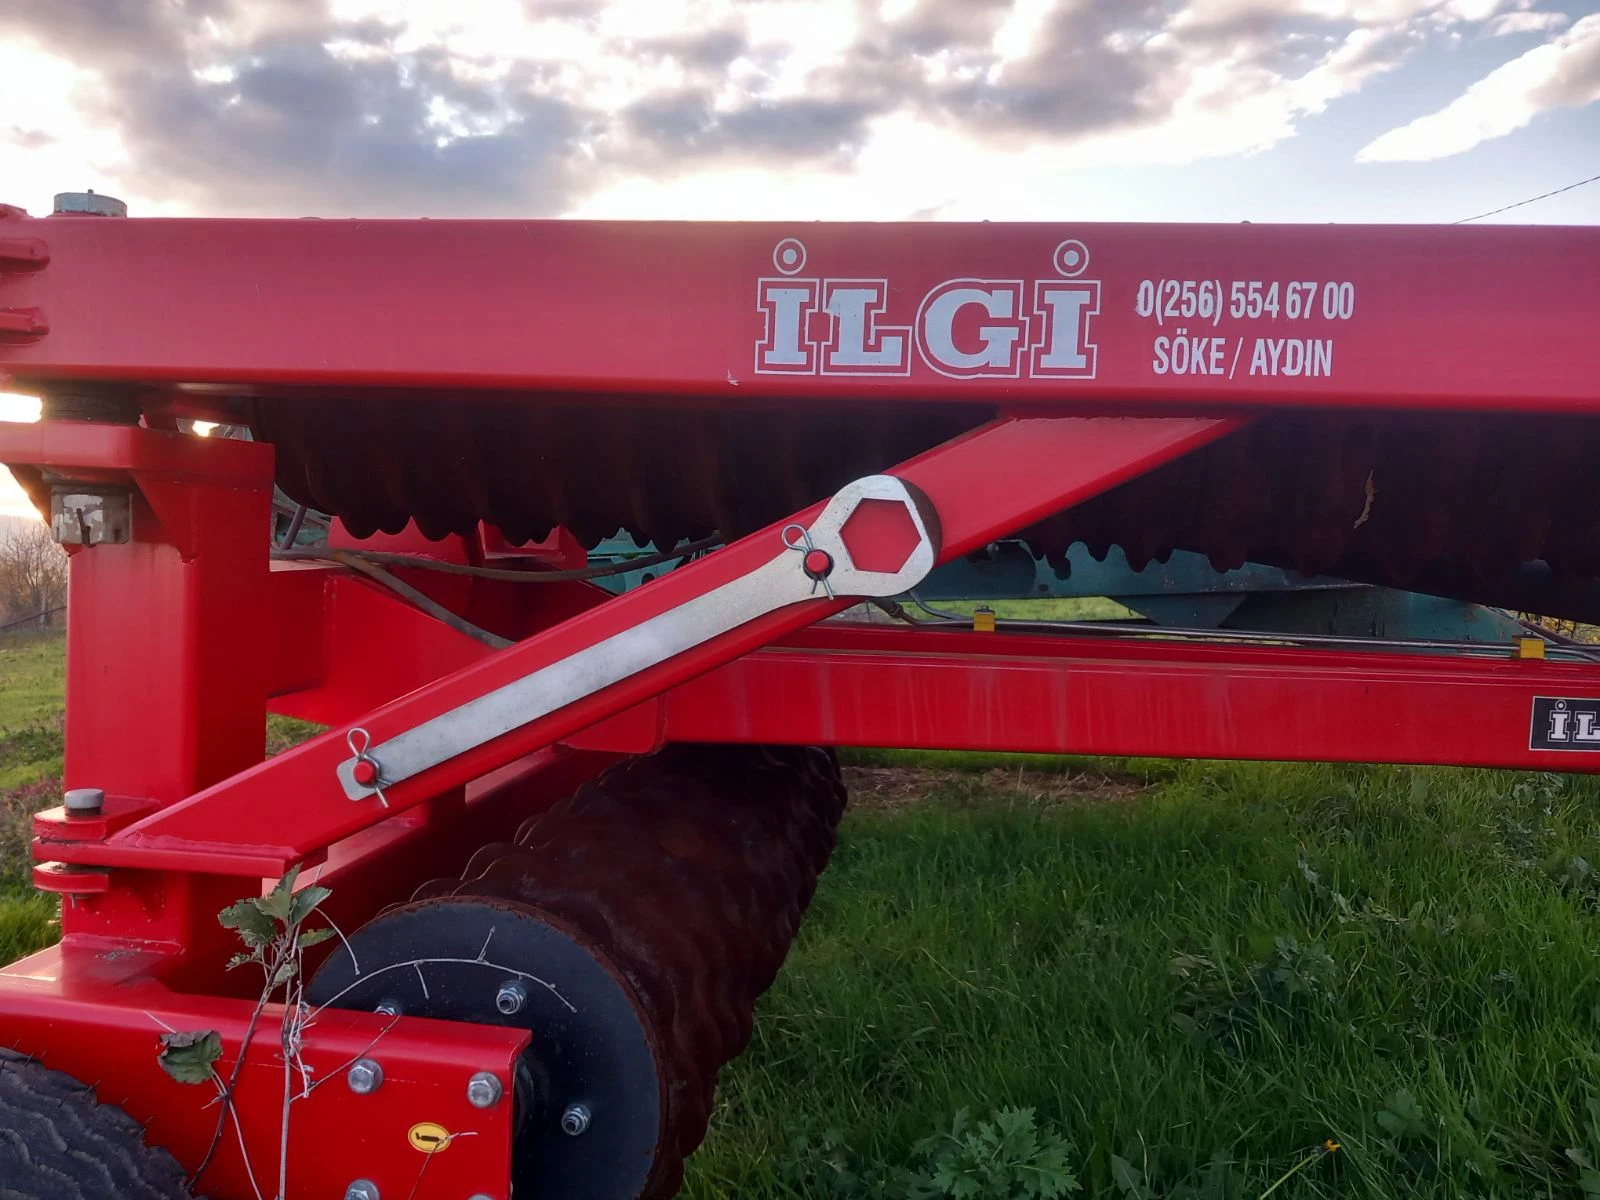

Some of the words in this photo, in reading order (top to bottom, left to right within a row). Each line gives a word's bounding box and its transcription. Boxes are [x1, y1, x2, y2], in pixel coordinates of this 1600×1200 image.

[754, 237, 1101, 380] İLGİ
[1136, 279, 1223, 327] 0(256)
[1230, 280, 1280, 319] 554
[1285, 281, 1318, 320] 67
[1322, 281, 1355, 320] 00
[1152, 327, 1226, 375] SÖKE
[1228, 336, 1244, 380] /
[1249, 338, 1333, 377] AYDIN
